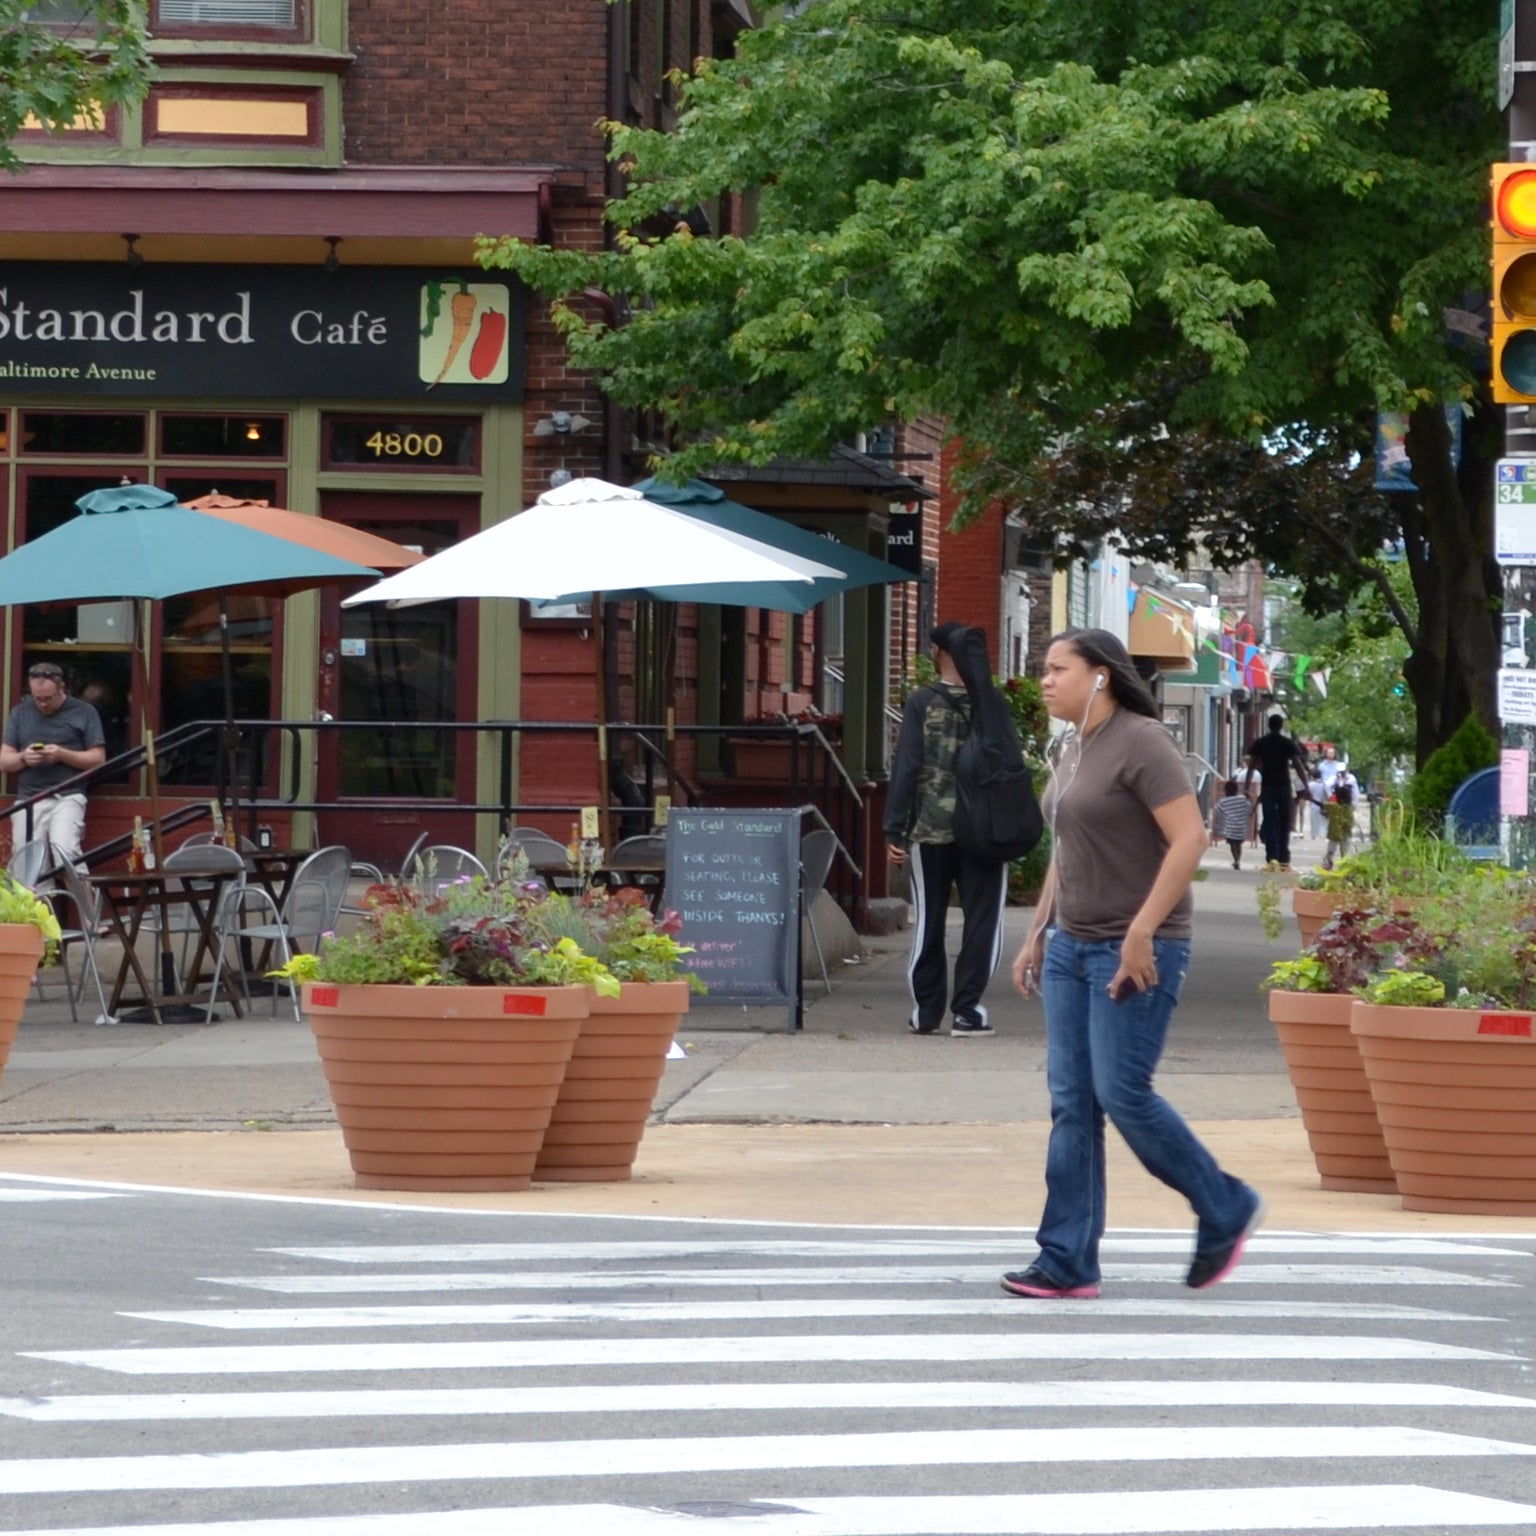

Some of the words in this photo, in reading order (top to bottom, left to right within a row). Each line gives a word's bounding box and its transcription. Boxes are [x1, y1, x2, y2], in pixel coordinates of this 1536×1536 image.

[290, 310, 388, 345] Café
[85, 362, 157, 380] Avenue
[366, 431, 443, 456] 4800
[1499, 484, 1524, 503] 34
[683, 852, 705, 864] FOR
[682, 890, 704, 902] SEE
[717, 891, 766, 904] SOMEONE
[684, 910, 724, 922] INSIDE
[735, 911, 785, 925] THANKS!
